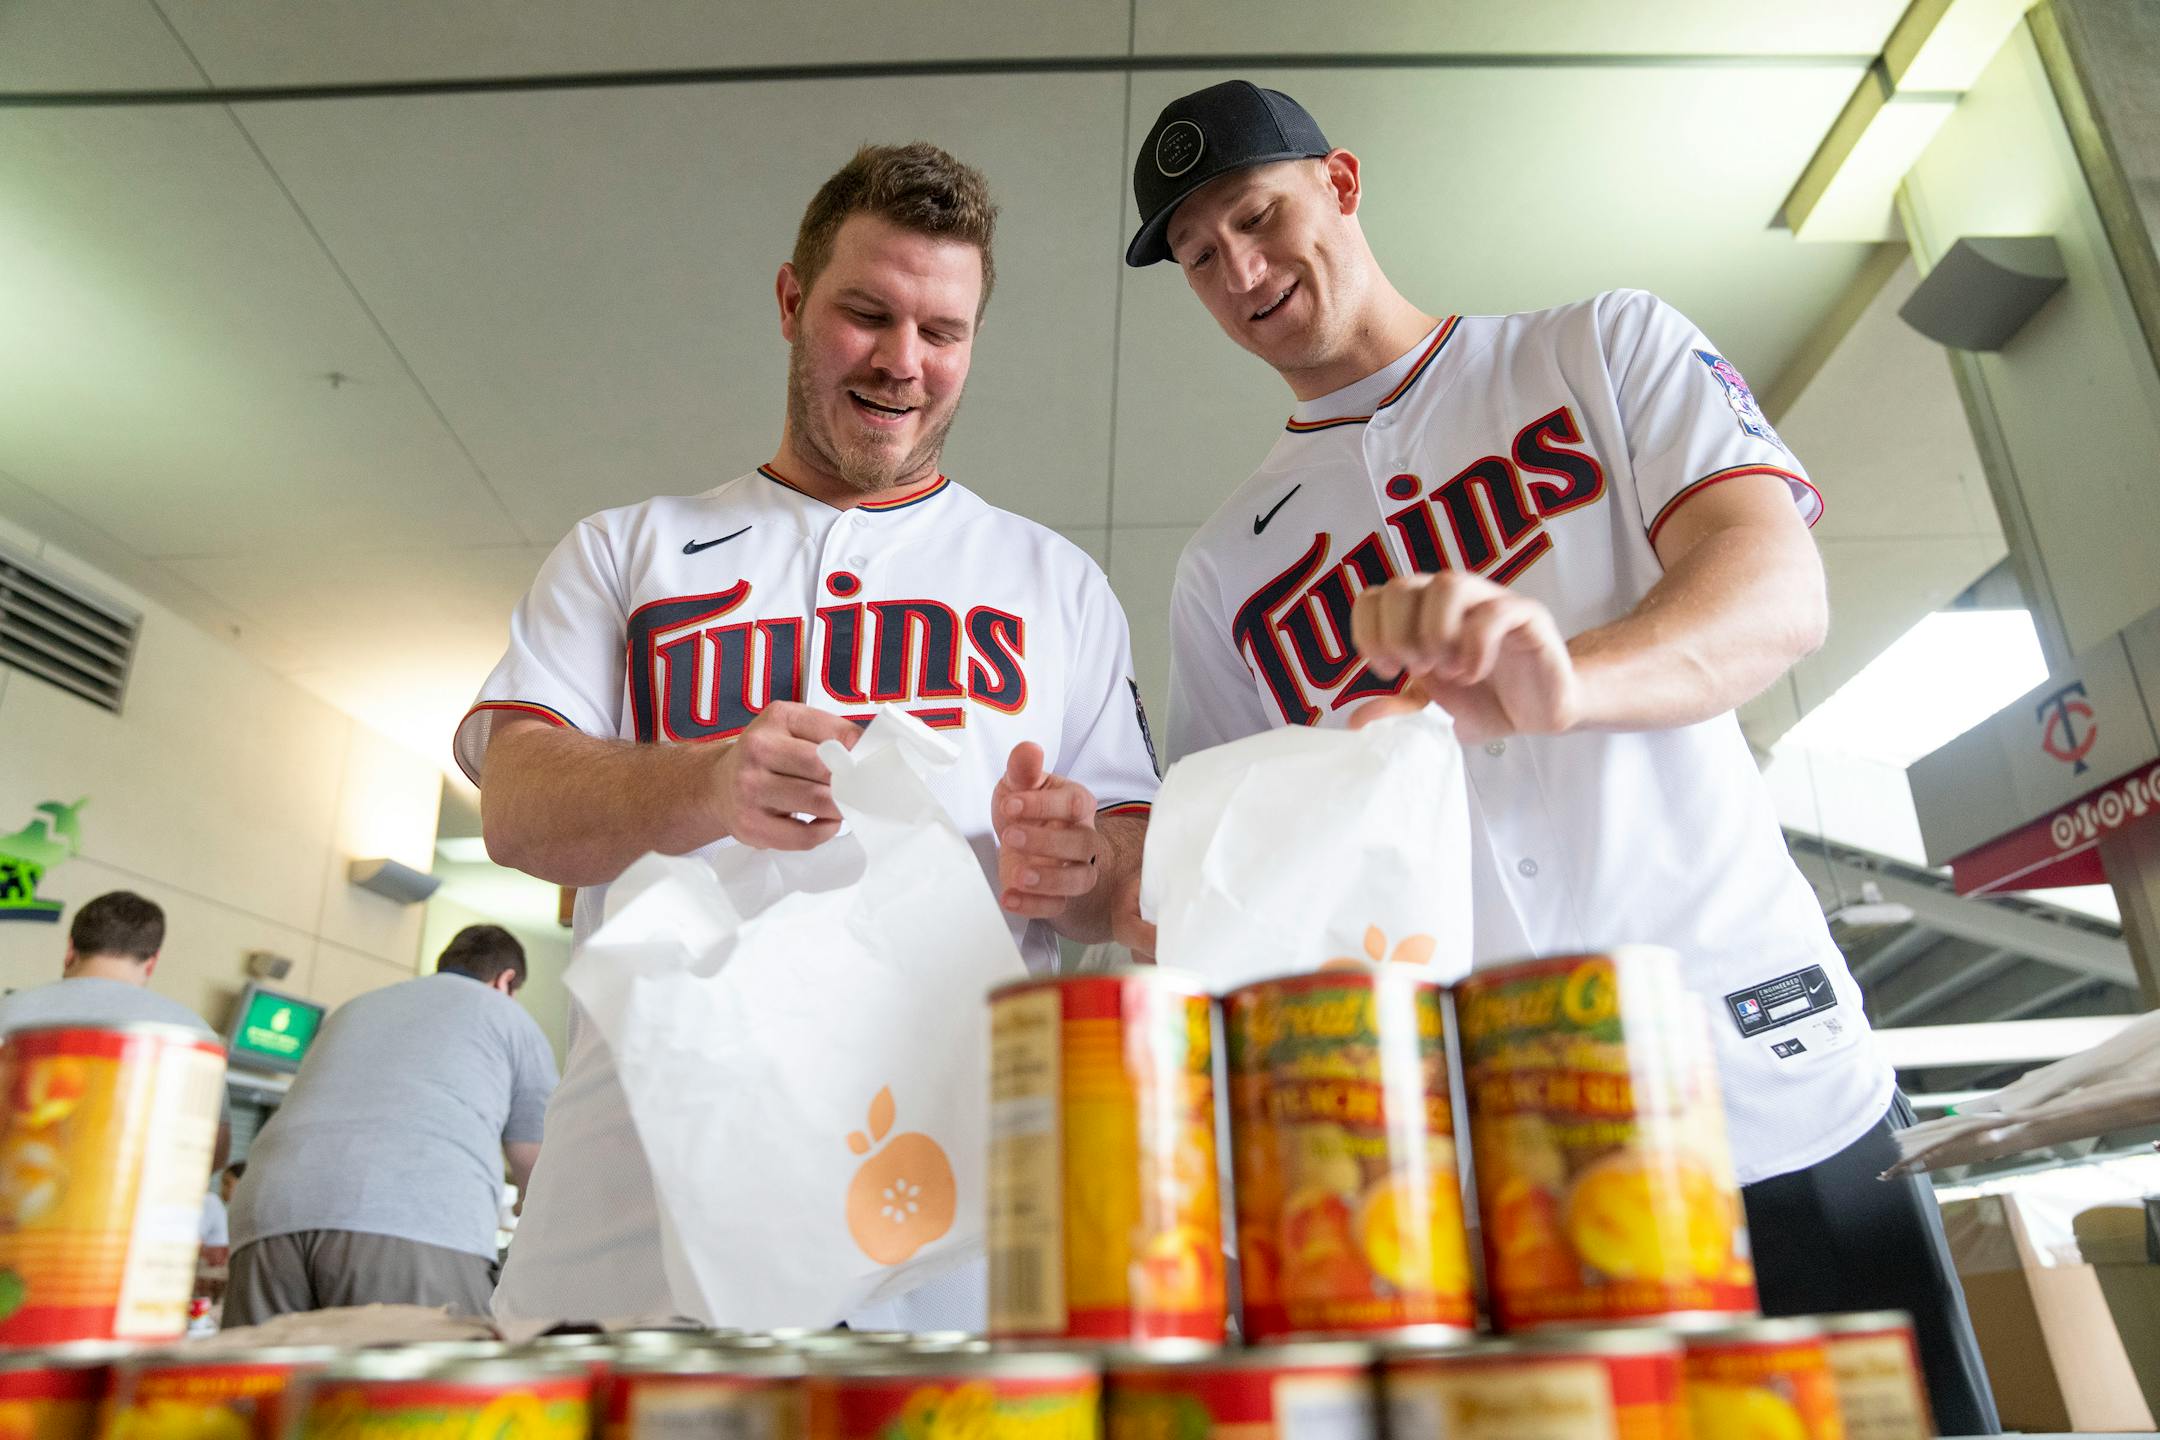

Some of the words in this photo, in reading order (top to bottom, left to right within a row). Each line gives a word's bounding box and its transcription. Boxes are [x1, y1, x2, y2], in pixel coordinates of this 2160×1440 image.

[1233, 405, 1607, 728] Twins
[627, 579, 1029, 744] Twins
[1758, 977, 1800, 996] ENGINEERED
